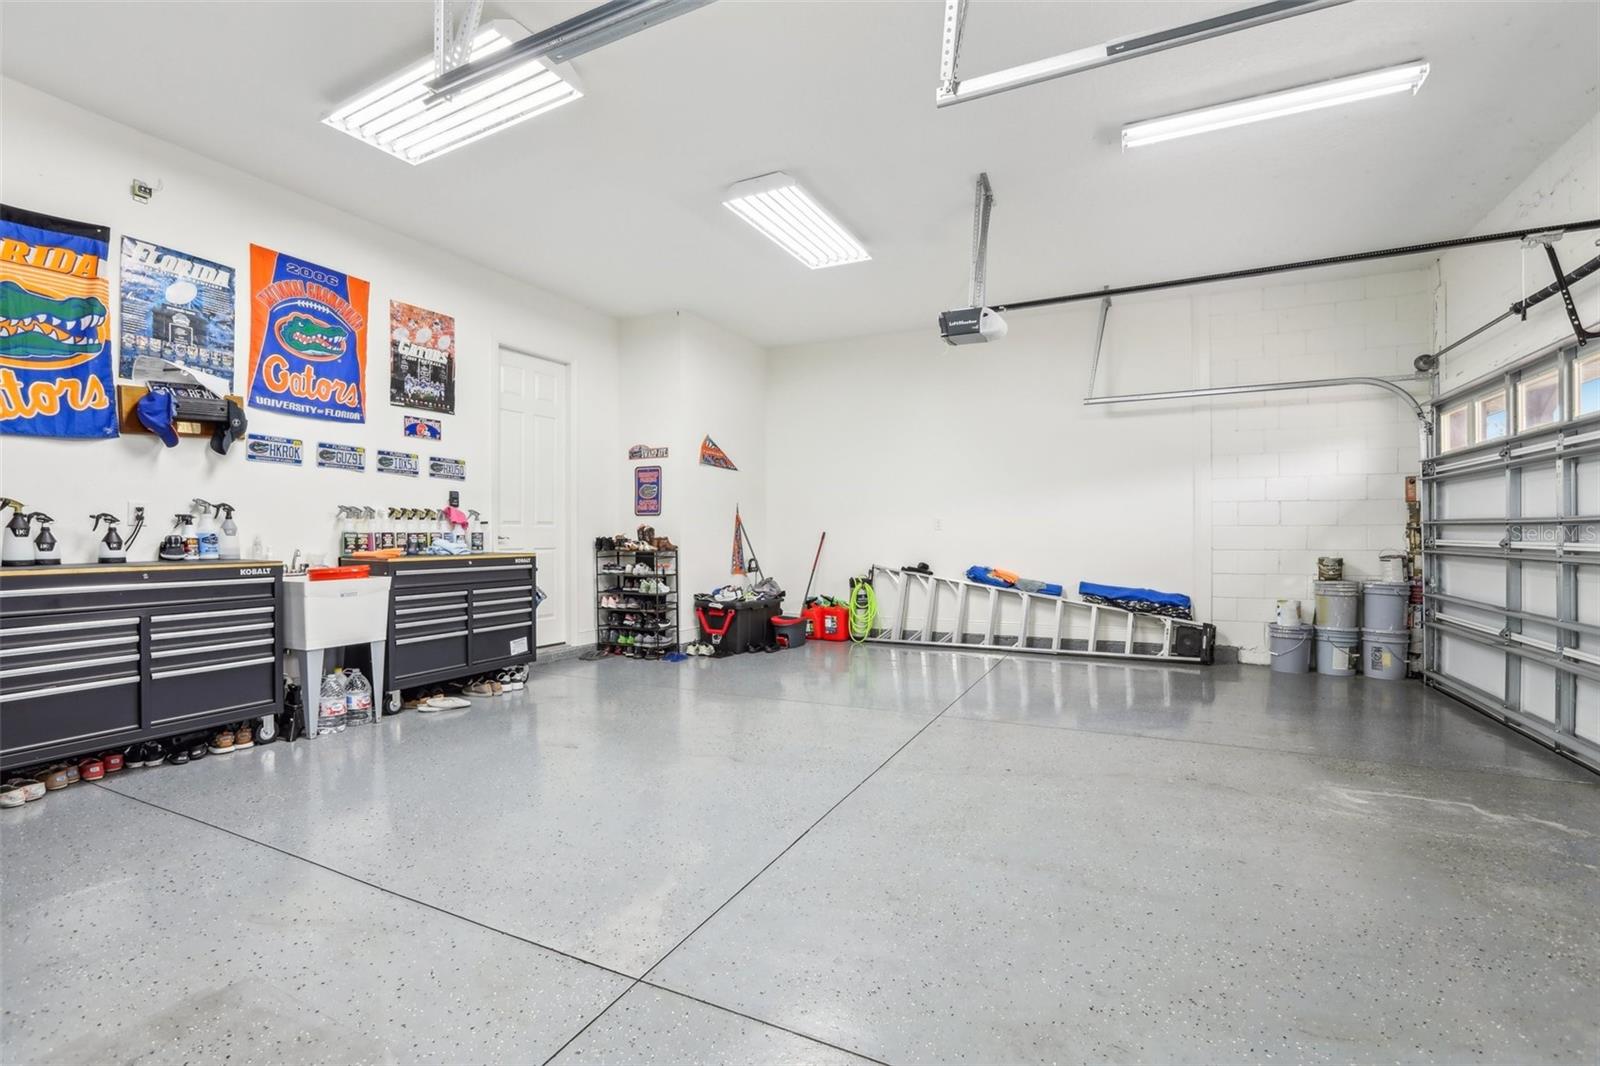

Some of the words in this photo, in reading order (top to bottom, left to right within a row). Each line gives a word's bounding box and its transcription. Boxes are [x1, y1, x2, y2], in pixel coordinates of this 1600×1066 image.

[0, 237, 99, 279] RIDA
[286, 262, 339, 286] 2006
[263, 354, 359, 408] Gators
[256, 396, 317, 414] UNIVERSITY
[325, 408, 361, 420] FLORIDA
